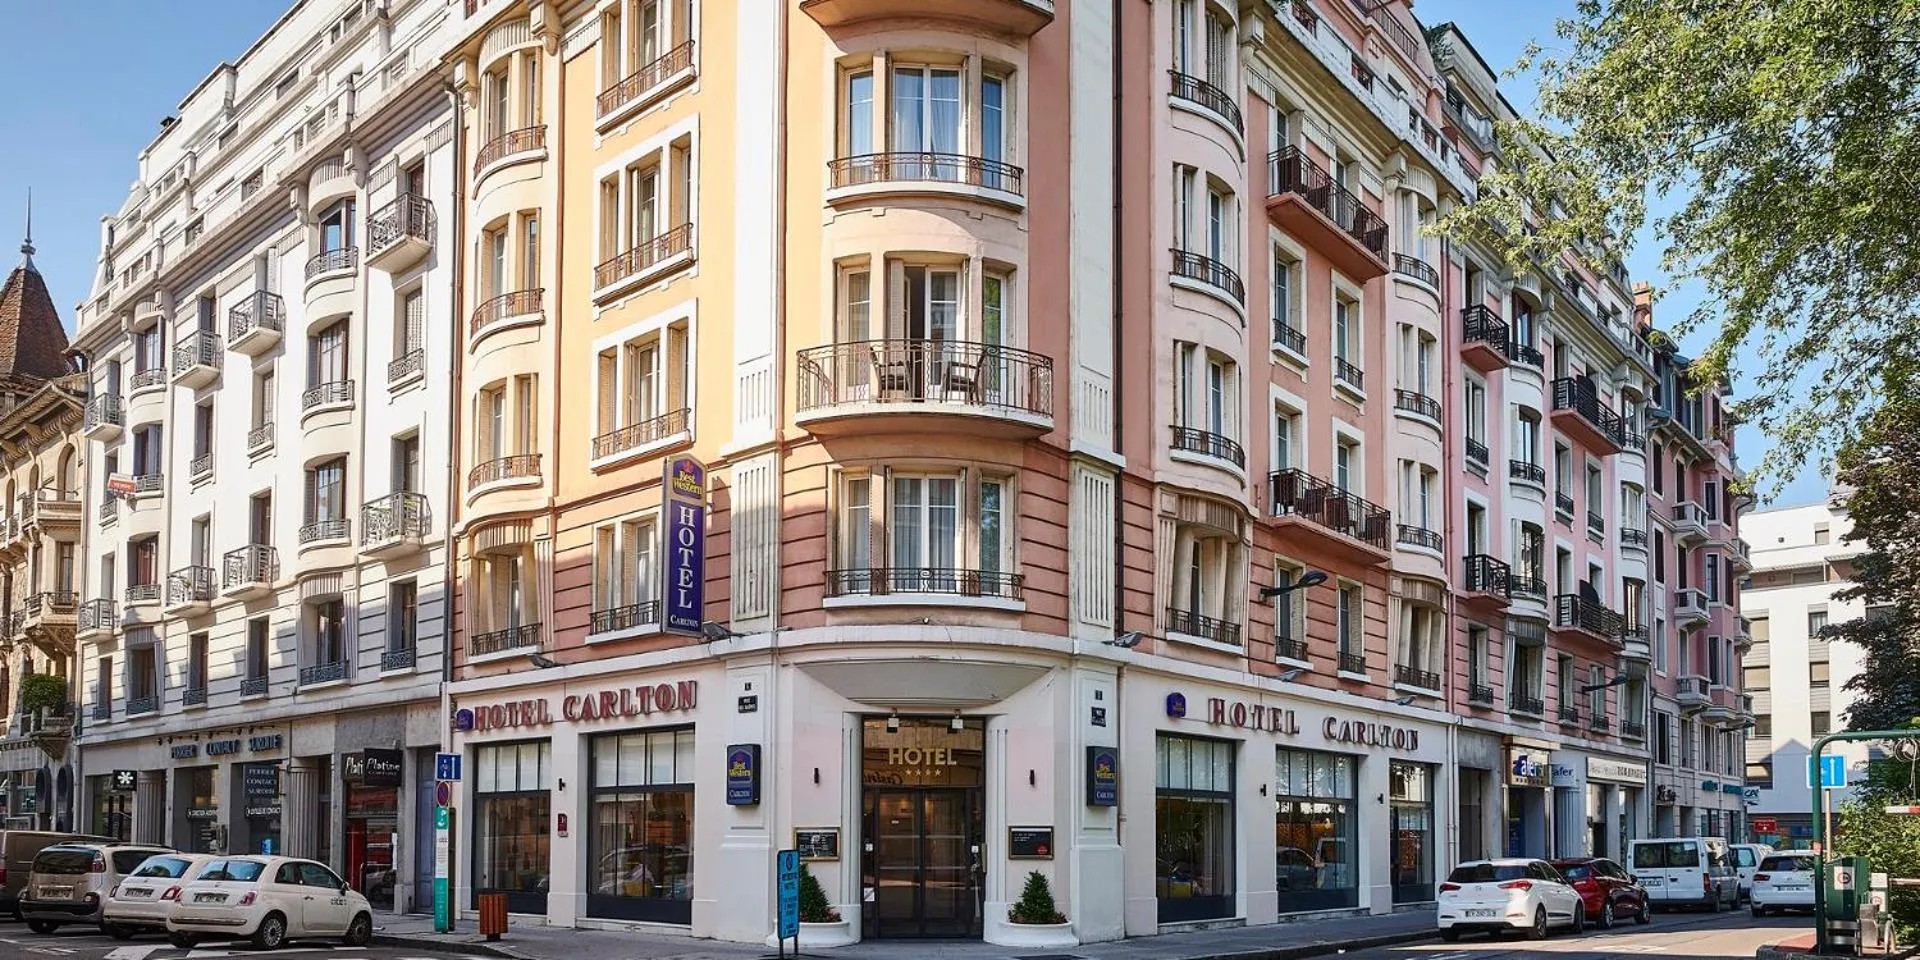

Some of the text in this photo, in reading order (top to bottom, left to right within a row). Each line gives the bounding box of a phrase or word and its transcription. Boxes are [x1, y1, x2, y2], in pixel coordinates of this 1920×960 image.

[672, 477, 704, 496] Western
[680, 470, 696, 484] Best
[678, 506, 696, 609] HOTEL
[474, 680, 698, 732] HOTEL CARLTON
[1208, 698, 1419, 750] HOTEL CARLTON
[366, 757, 400, 771] Platine
[1553, 766, 1574, 777] afer
